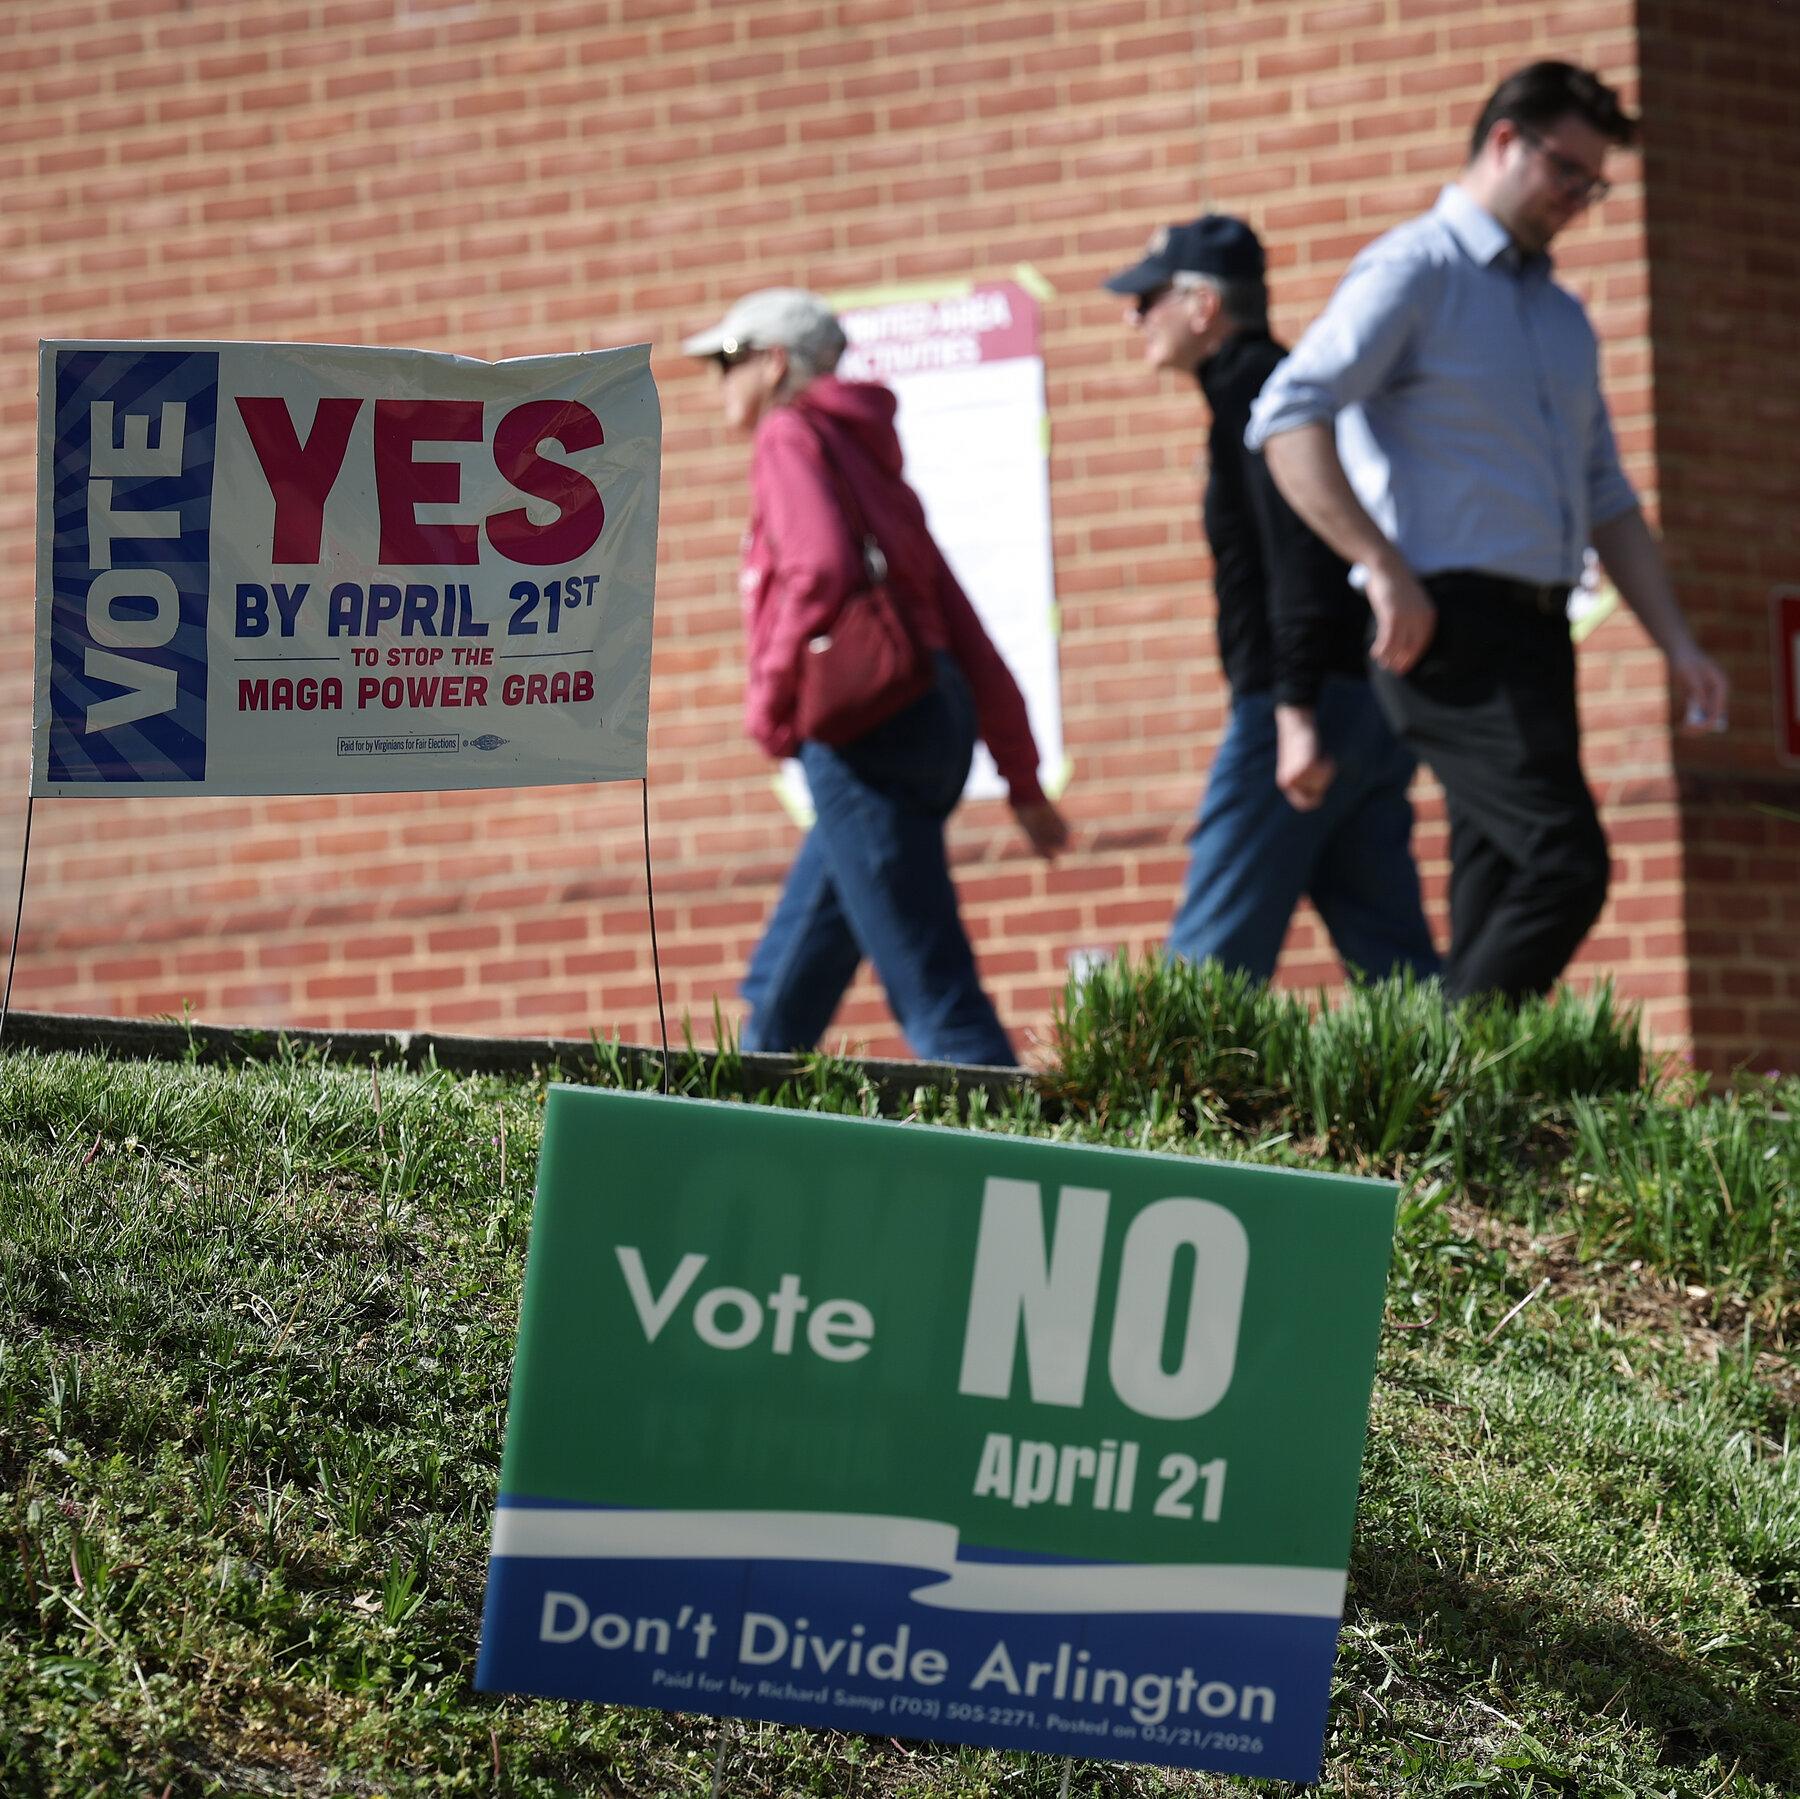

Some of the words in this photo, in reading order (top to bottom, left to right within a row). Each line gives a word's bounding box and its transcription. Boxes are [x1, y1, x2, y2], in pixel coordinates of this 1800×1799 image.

[234, 396, 606, 566] YES
[85, 400, 187, 733] VOTE
[235, 583, 310, 638] BY
[328, 582, 489, 637] APRIL
[508, 574, 600, 636] 21ST
[238, 677, 342, 711] MAGA
[358, 675, 489, 709] POWER
[502, 670, 594, 706] GRAB
[351, 648, 375, 666] TO
[386, 647, 443, 666] STOP
[452, 647, 494, 666] THE
[340, 740, 354, 751] Paid
[355, 740, 364, 750] for
[365, 740, 373, 753] by
[374, 739, 404, 753] Virginians
[405, 739, 414, 750] for
[415, 739, 427, 749] Fair
[428, 738, 457, 749] Elections
[614, 1244, 876, 1363] Vote
[959, 1176, 1250, 1421] NO
[973, 1433, 1140, 1513] April
[1154, 1454, 1228, 1523] 21
[539, 1591, 717, 1660] Don't
[739, 1611, 949, 1686] Divide
[970, 1641, 1277, 1726] Arlington
[653, 1669, 693, 1690] Paid
[698, 1672, 722, 1692] for
[729, 1675, 752, 1698] by
[758, 1680, 828, 1705] Richard
[890, 1694, 940, 1720] (703)
[1046, 1712, 1108, 1737] Posted
[1112, 1723, 1137, 1740] on
